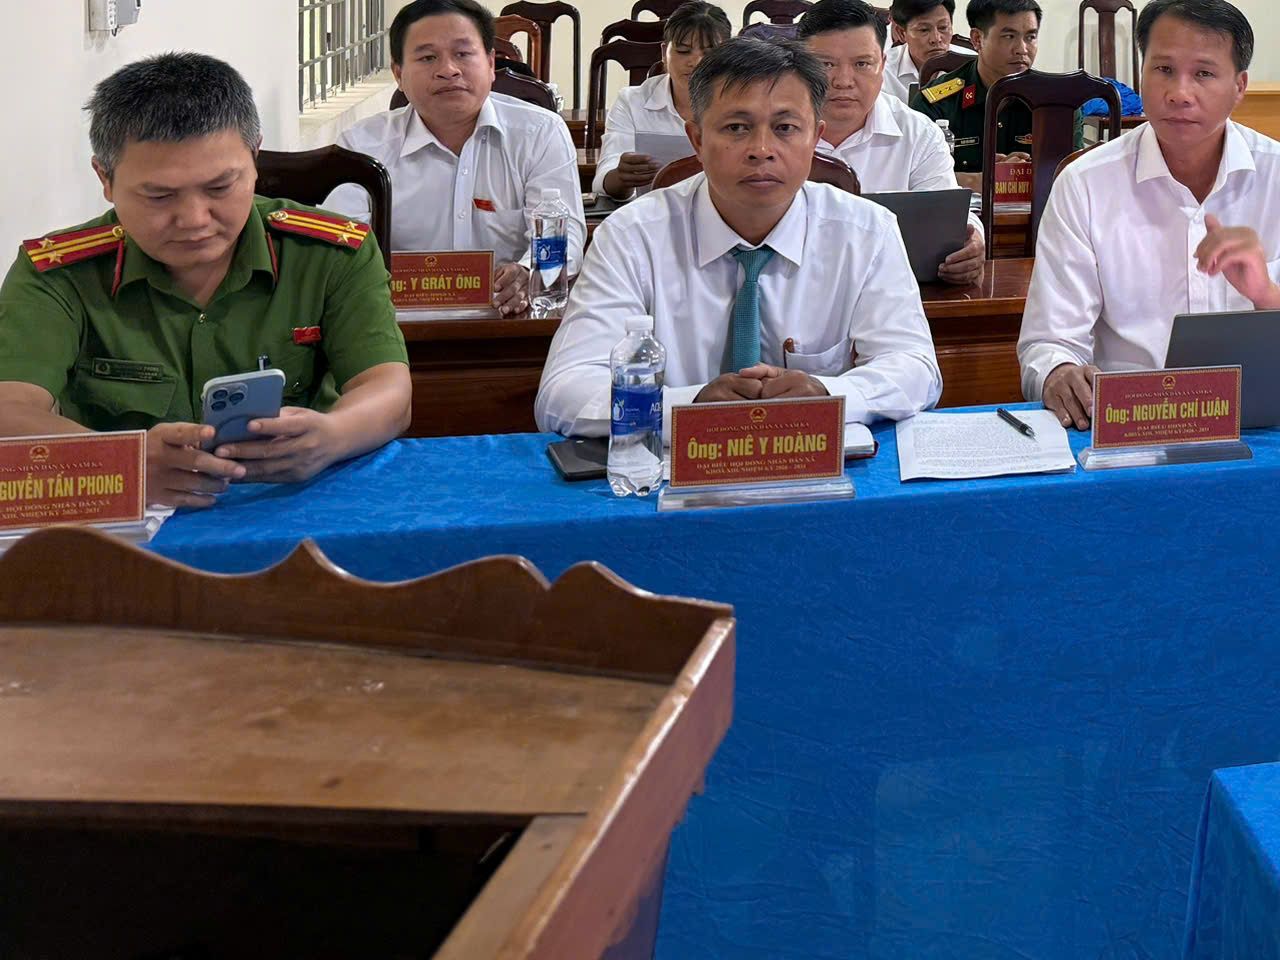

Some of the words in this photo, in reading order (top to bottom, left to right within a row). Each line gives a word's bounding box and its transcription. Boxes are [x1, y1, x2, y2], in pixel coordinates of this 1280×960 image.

[391, 280, 407, 292] ng:
[410, 277, 418, 290] Y
[421, 274, 453, 290] GRÁT
[456, 273, 481, 289] ÔNG
[1105, 403, 1130, 424] Ông:
[1133, 397, 1177, 422] NGUYỄN
[1180, 398, 1199, 418] CHÍ
[1201, 396, 1229, 420] LUẬN
[687, 437, 722, 460] Ông:
[727, 434, 753, 457] NIÊ
[759, 437, 768, 455] Y
[773, 431, 827, 454] HOÀNG
[0, 473, 43, 501] GUYỄN
[48, 471, 74, 498] TẤN
[78, 474, 124, 496] PHONG
